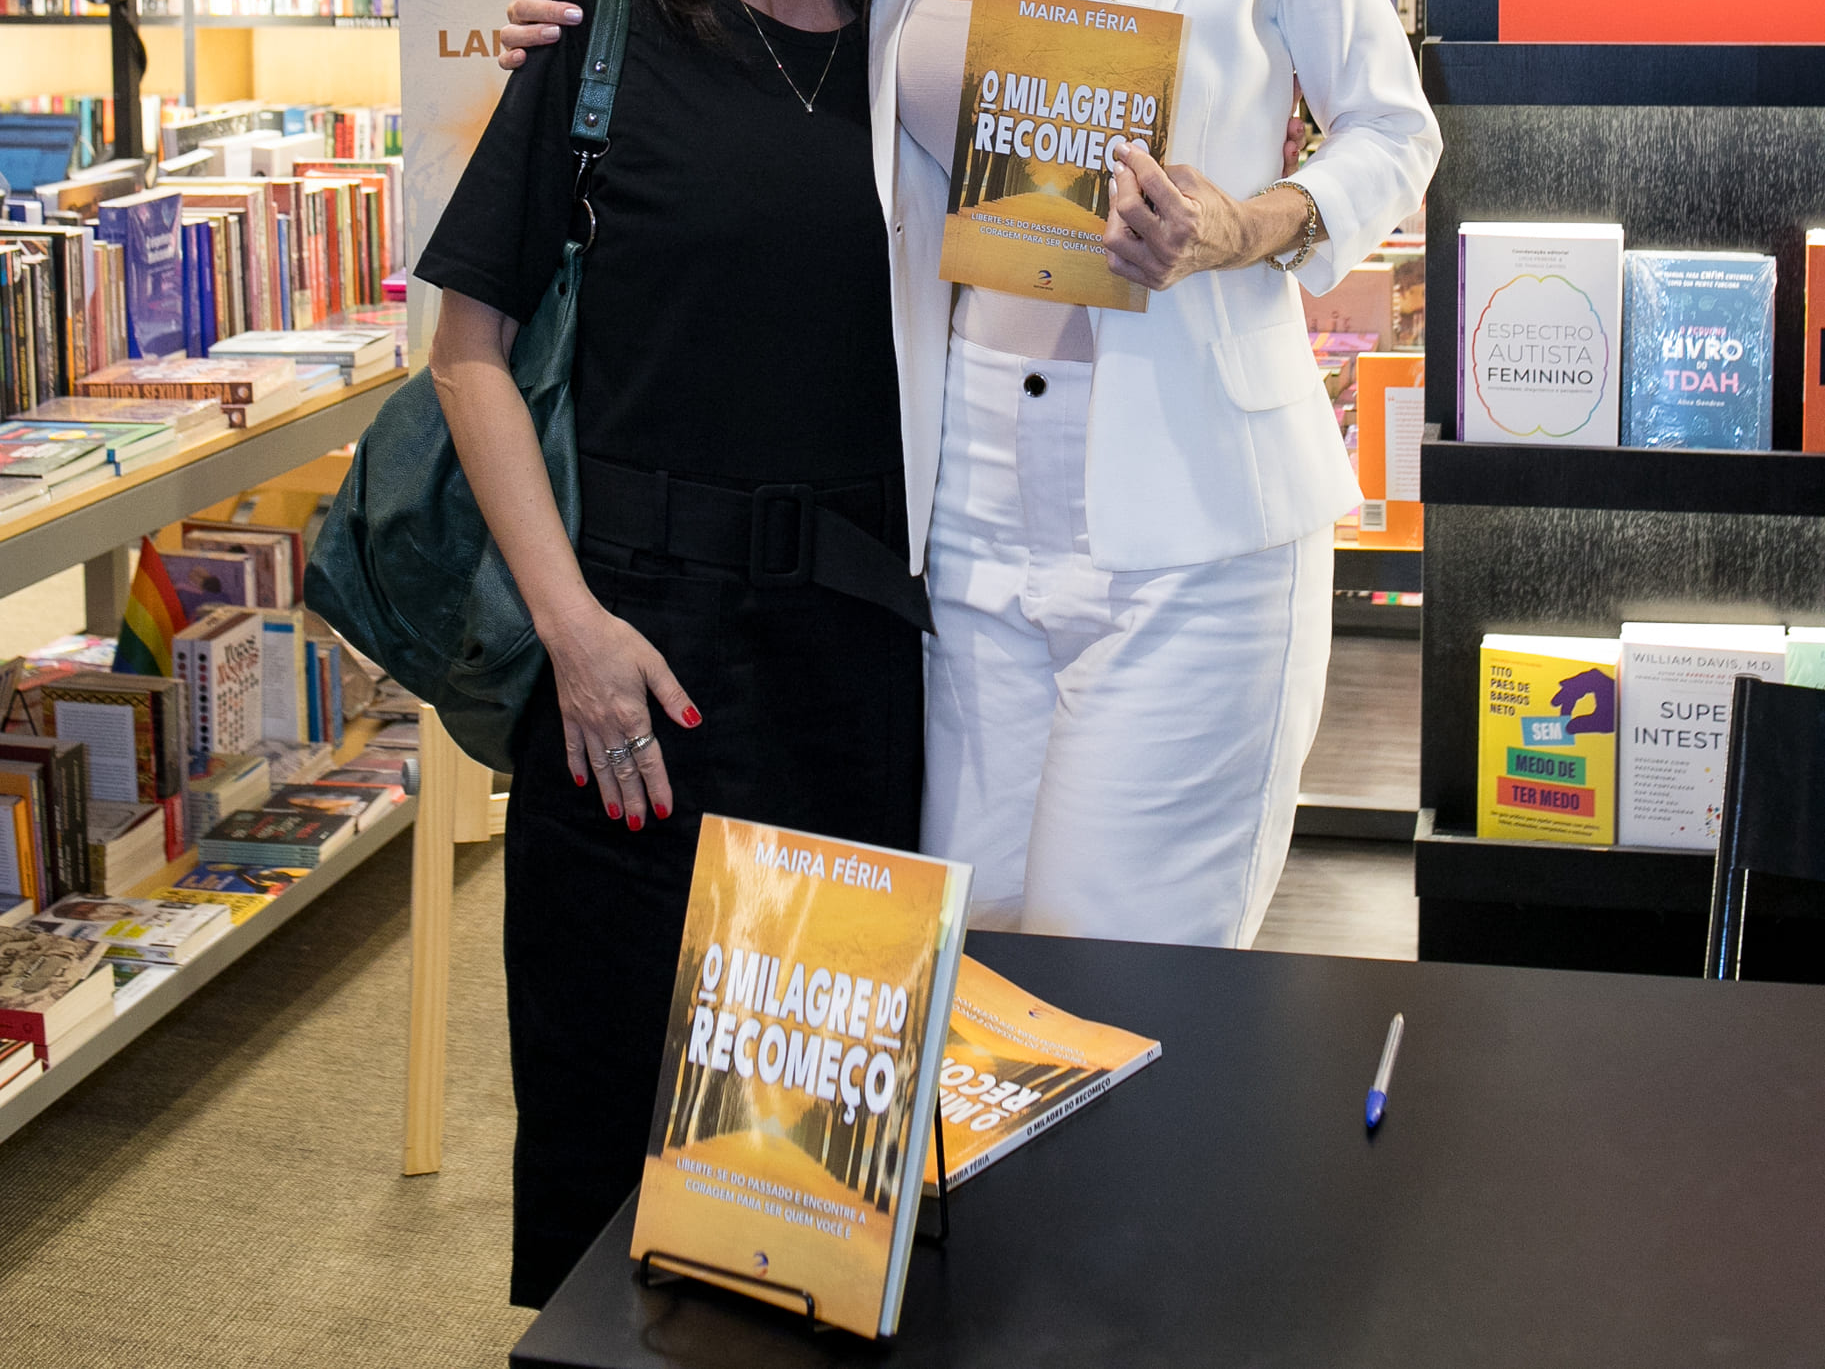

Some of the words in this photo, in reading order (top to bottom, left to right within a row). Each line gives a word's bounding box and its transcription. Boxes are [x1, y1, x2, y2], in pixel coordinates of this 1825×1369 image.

[1019, 0, 1079, 25] MAIRA
[1084, 9, 1138, 33] FÉRIA
[981, 70, 999, 103] O
[1003, 72, 1127, 129] MILAGRE
[1131, 93, 1157, 125] DO
[971, 212, 1014, 227] LIBERTE-SE
[1017, 220, 1029, 229] DO
[1030, 222, 1069, 236] PASSADO
[1071, 229, 1076, 237] E
[1078, 230, 1104, 242] ENCO
[980, 226, 1021, 240] CORAGEM
[1022, 233, 1043, 244] PARA
[1045, 238, 1061, 247] SER
[1063, 240, 1087, 251] QUEM
[1089, 245, 1107, 255] VOC
[1487, 322, 1594, 342] ESPECTRO
[1487, 343, 1593, 365] AUTISTA
[1661, 337, 1744, 362] LIVRO
[1487, 367, 1593, 386] FEMININO
[1696, 360, 1708, 370] DO
[1663, 369, 1739, 394] TDAH
[1490, 665, 1512, 678] TITO
[1632, 652, 1692, 667] WILLIAM
[1697, 656, 1743, 671] DAVIS,
[1746, 660, 1775, 673] M.D.
[1490, 678, 1516, 691] PAES
[1517, 681, 1530, 693] DE
[1489, 703, 1515, 717] NETO
[1490, 691, 1530, 706] BARROS
[1660, 700, 1727, 723] SUPE
[1531, 722, 1563, 741] SEM
[1634, 726, 1729, 750] INTEST
[1515, 754, 1555, 776] MEDO
[1558, 760, 1576, 779] DE
[1511, 784, 1537, 805] TER
[1540, 789, 1580, 811] MEDO
[755, 841, 825, 879] MAIRA
[831, 854, 893, 894] FÉRIA
[702, 943, 724, 992] O
[724, 948, 873, 1039] MILAGRE
[875, 982, 908, 1035] DO
[688, 1005, 896, 1125] RECOMEÇO
[1026, 1126, 1033, 1136] O
[1034, 1106, 1063, 1132] MILAGRE
[1064, 1100, 1074, 1112] DO
[1075, 1077, 1111, 1104] RECOMEÇO
[970, 1112, 1001, 1132] O
[685, 1178, 735, 1203] CORAGEM
[736, 1193, 761, 1212] PARA
[764, 1202, 782, 1218] SER
[784, 1206, 813, 1227] QUEM
[816, 1218, 843, 1237] VOCÊ
[731, 1173, 746, 1187] DO
[747, 1177, 793, 1202] PASSADO
[794, 1191, 800, 1203] E
[803, 1193, 856, 1222] ENCONTRE
[858, 1210, 866, 1225] A
